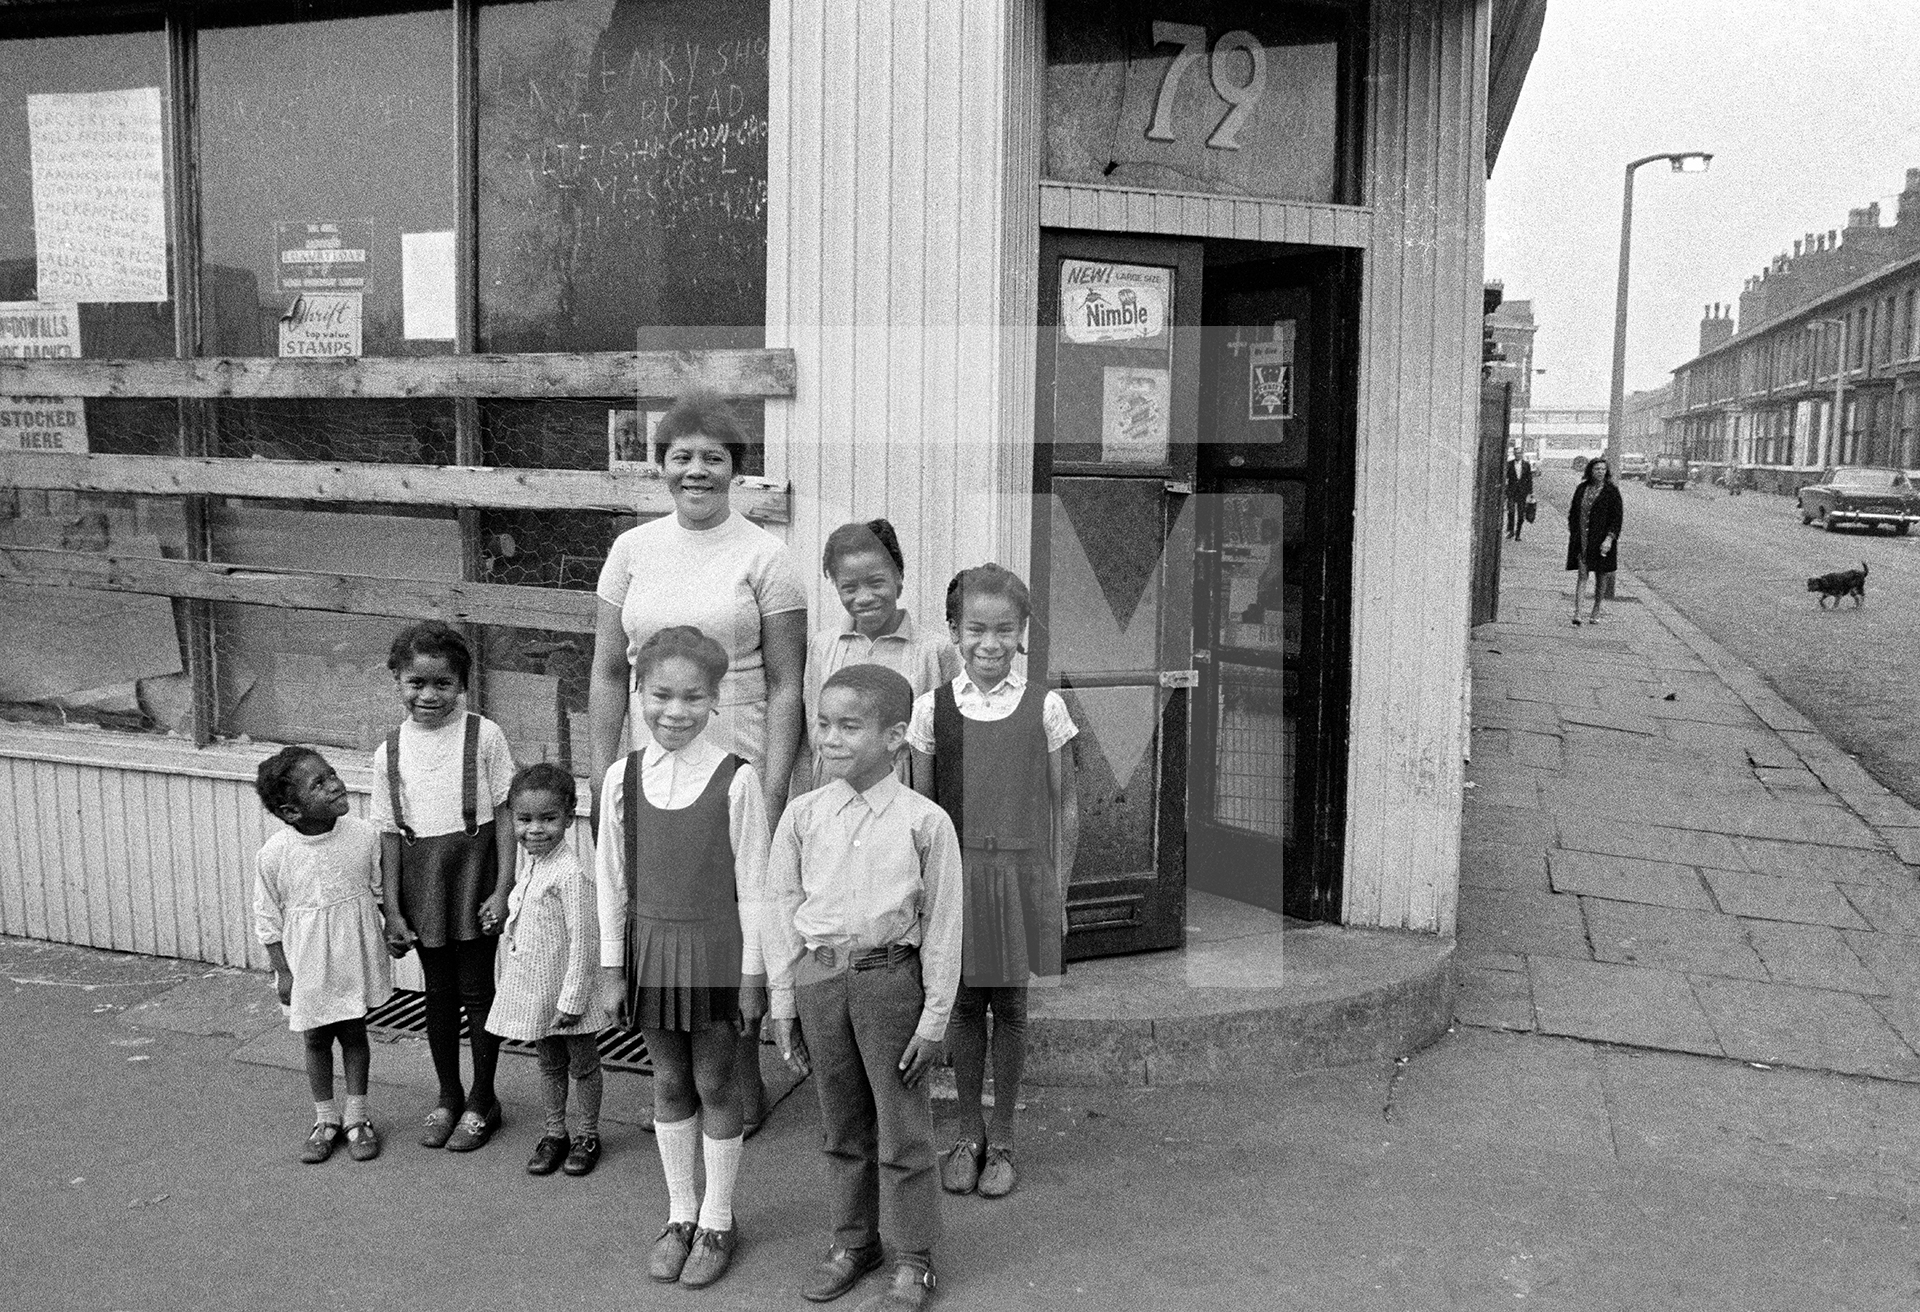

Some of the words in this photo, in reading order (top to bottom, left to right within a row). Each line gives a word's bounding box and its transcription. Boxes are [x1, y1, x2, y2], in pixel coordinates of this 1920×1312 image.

[1146, 20, 1267, 151] 79
[1067, 265, 1114, 285] NEW!
[1144, 274, 1161, 283] SIZE
[1085, 302, 1148, 327] Nimble
[305, 330, 319, 340] top
[321, 331, 350, 339] value
[286, 341, 352, 355] STAMPS
[0, 410, 77, 428] STOCKED
[20, 432, 63, 449] HERE
